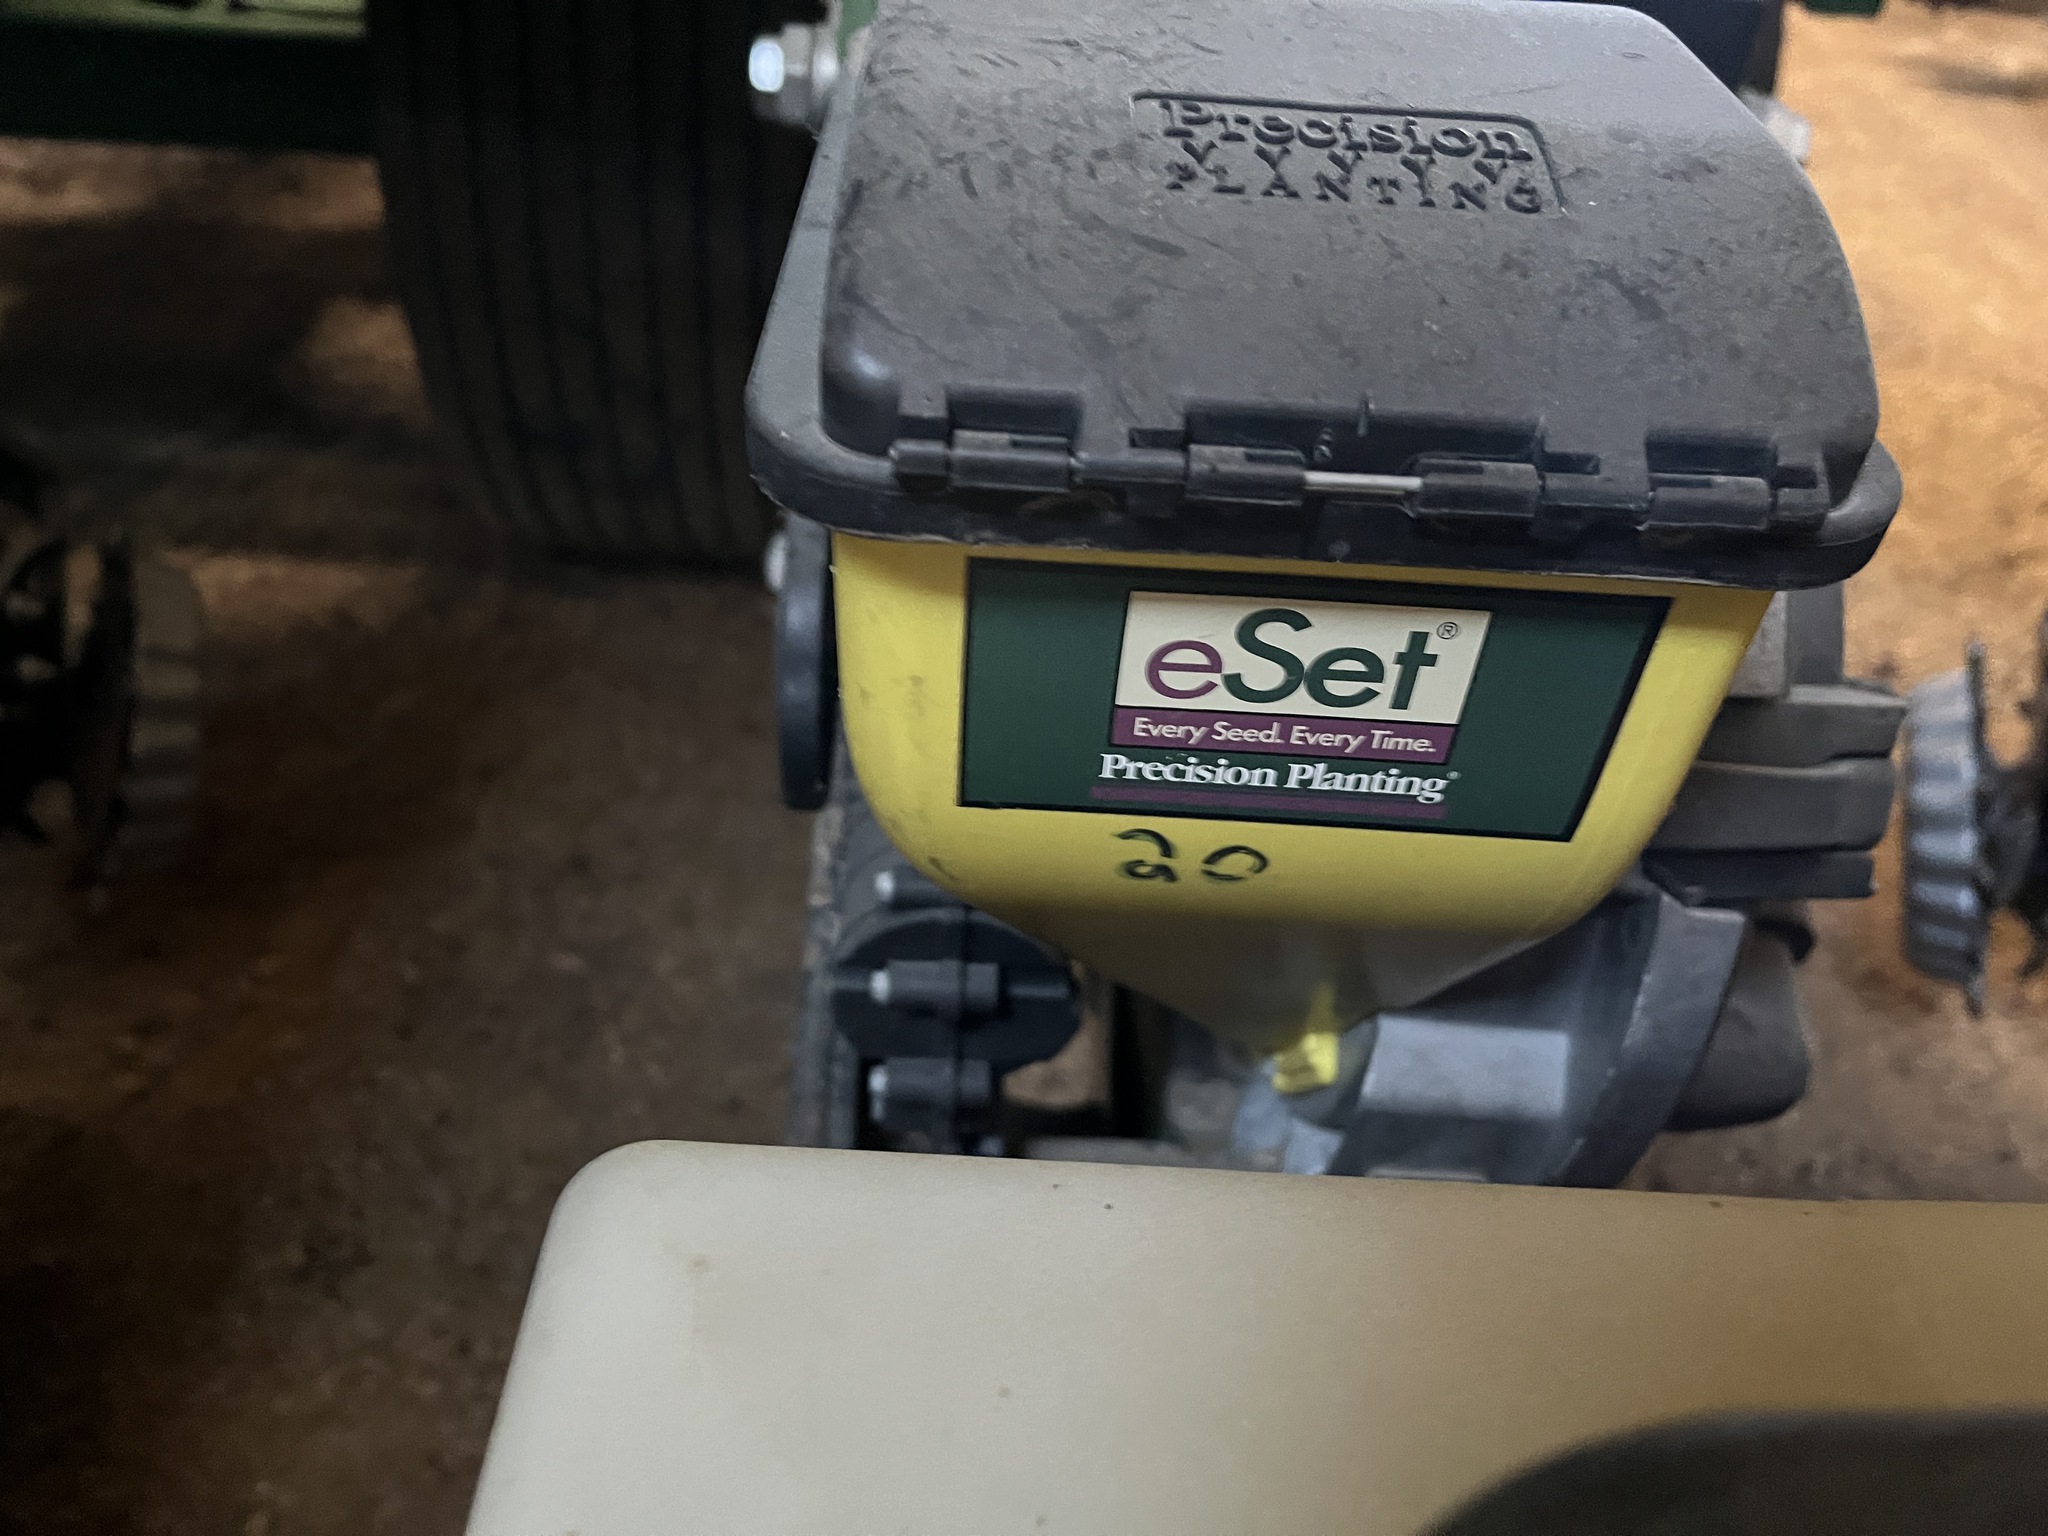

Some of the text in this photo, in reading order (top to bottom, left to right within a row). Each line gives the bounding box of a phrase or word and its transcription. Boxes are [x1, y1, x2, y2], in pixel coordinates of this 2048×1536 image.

[1159, 99, 1533, 162] Precision
[1165, 160, 1543, 214] PLANTING
[1133, 716, 1437, 754] Every Seed. Every Time.
[1098, 753, 1279, 787] Precision
